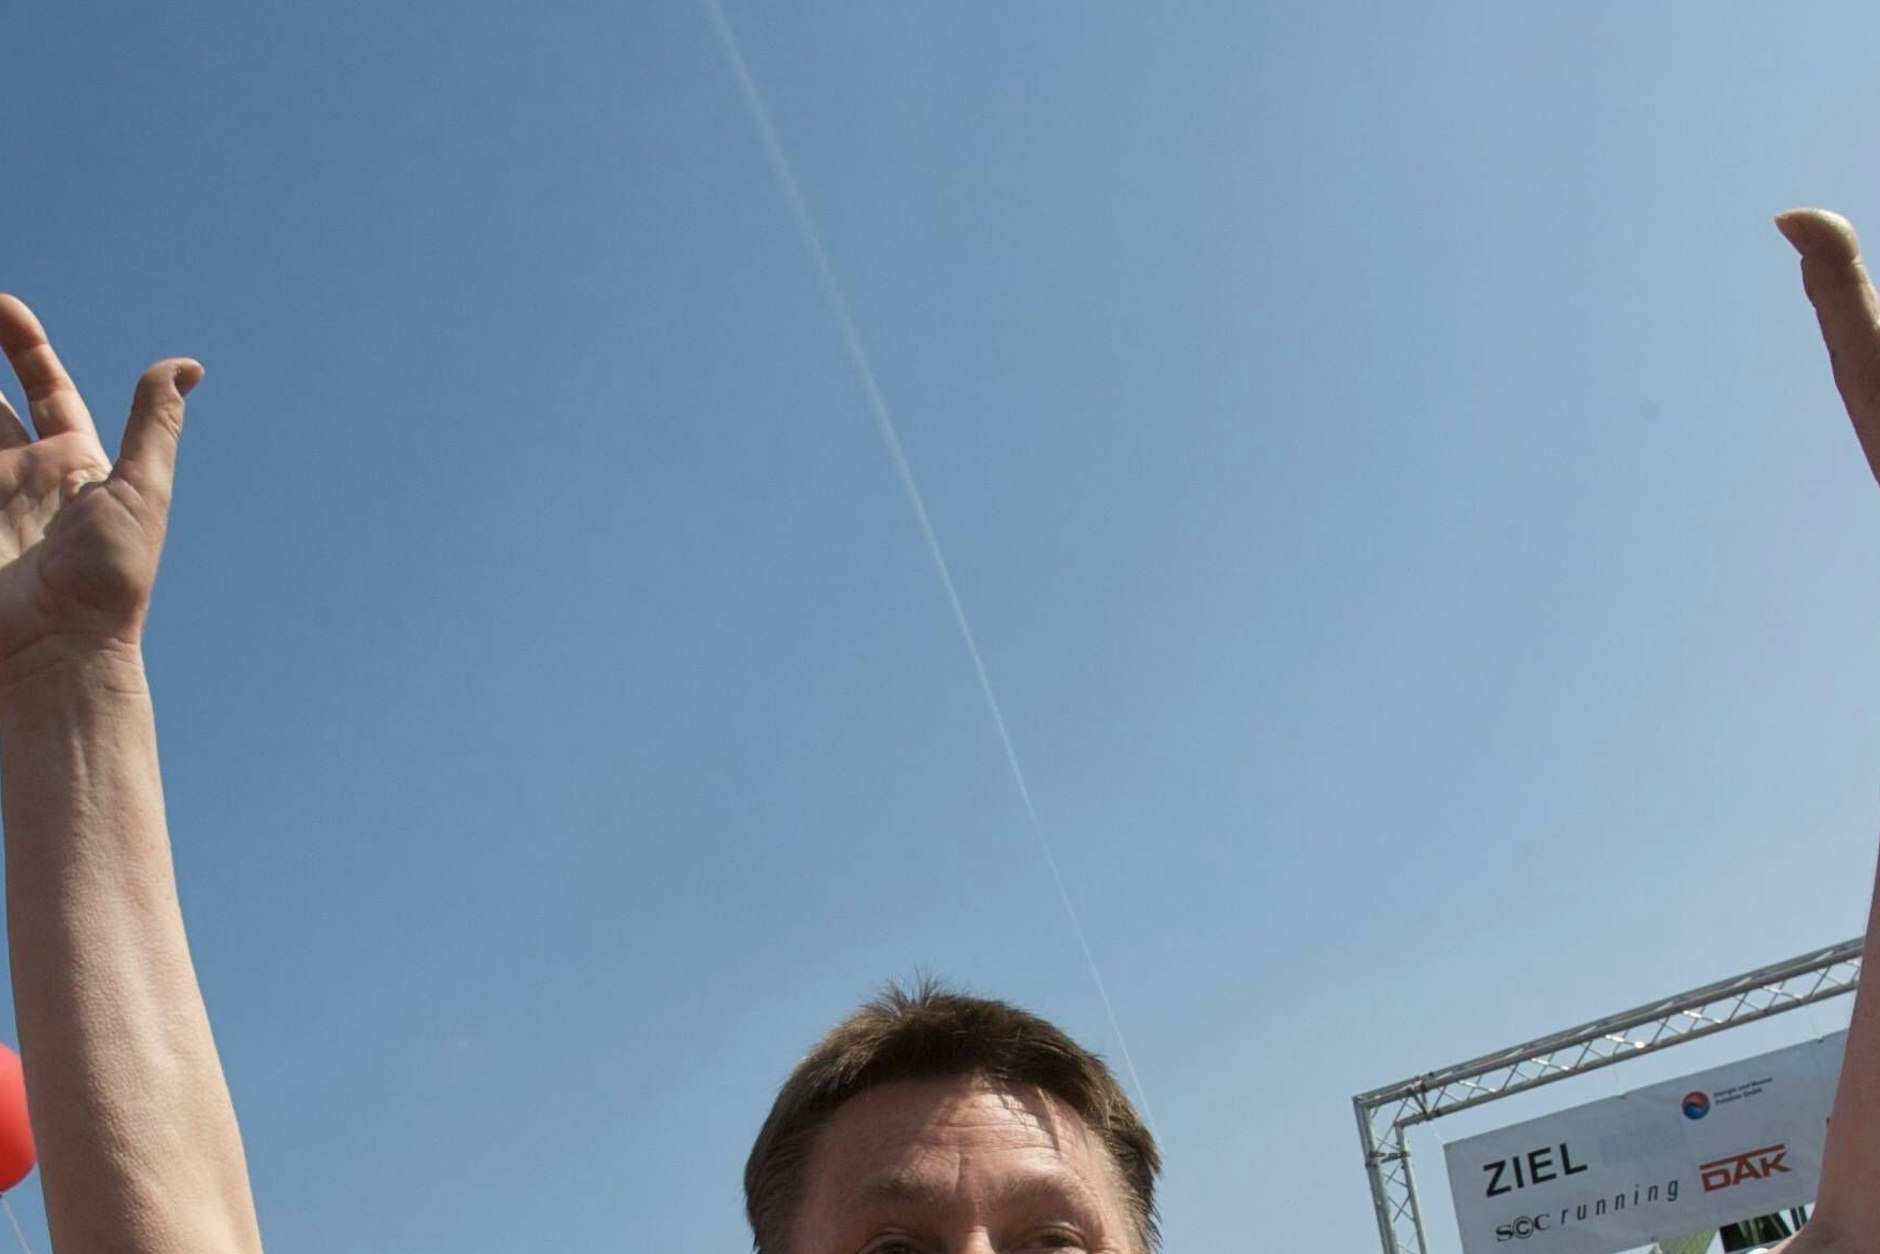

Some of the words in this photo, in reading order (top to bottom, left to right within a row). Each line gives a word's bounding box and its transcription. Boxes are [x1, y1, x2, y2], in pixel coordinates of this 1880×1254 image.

[1482, 1142, 1588, 1198] ZIEL
[1699, 1143, 1792, 1193] DAK
[1560, 1179, 1679, 1225] running
